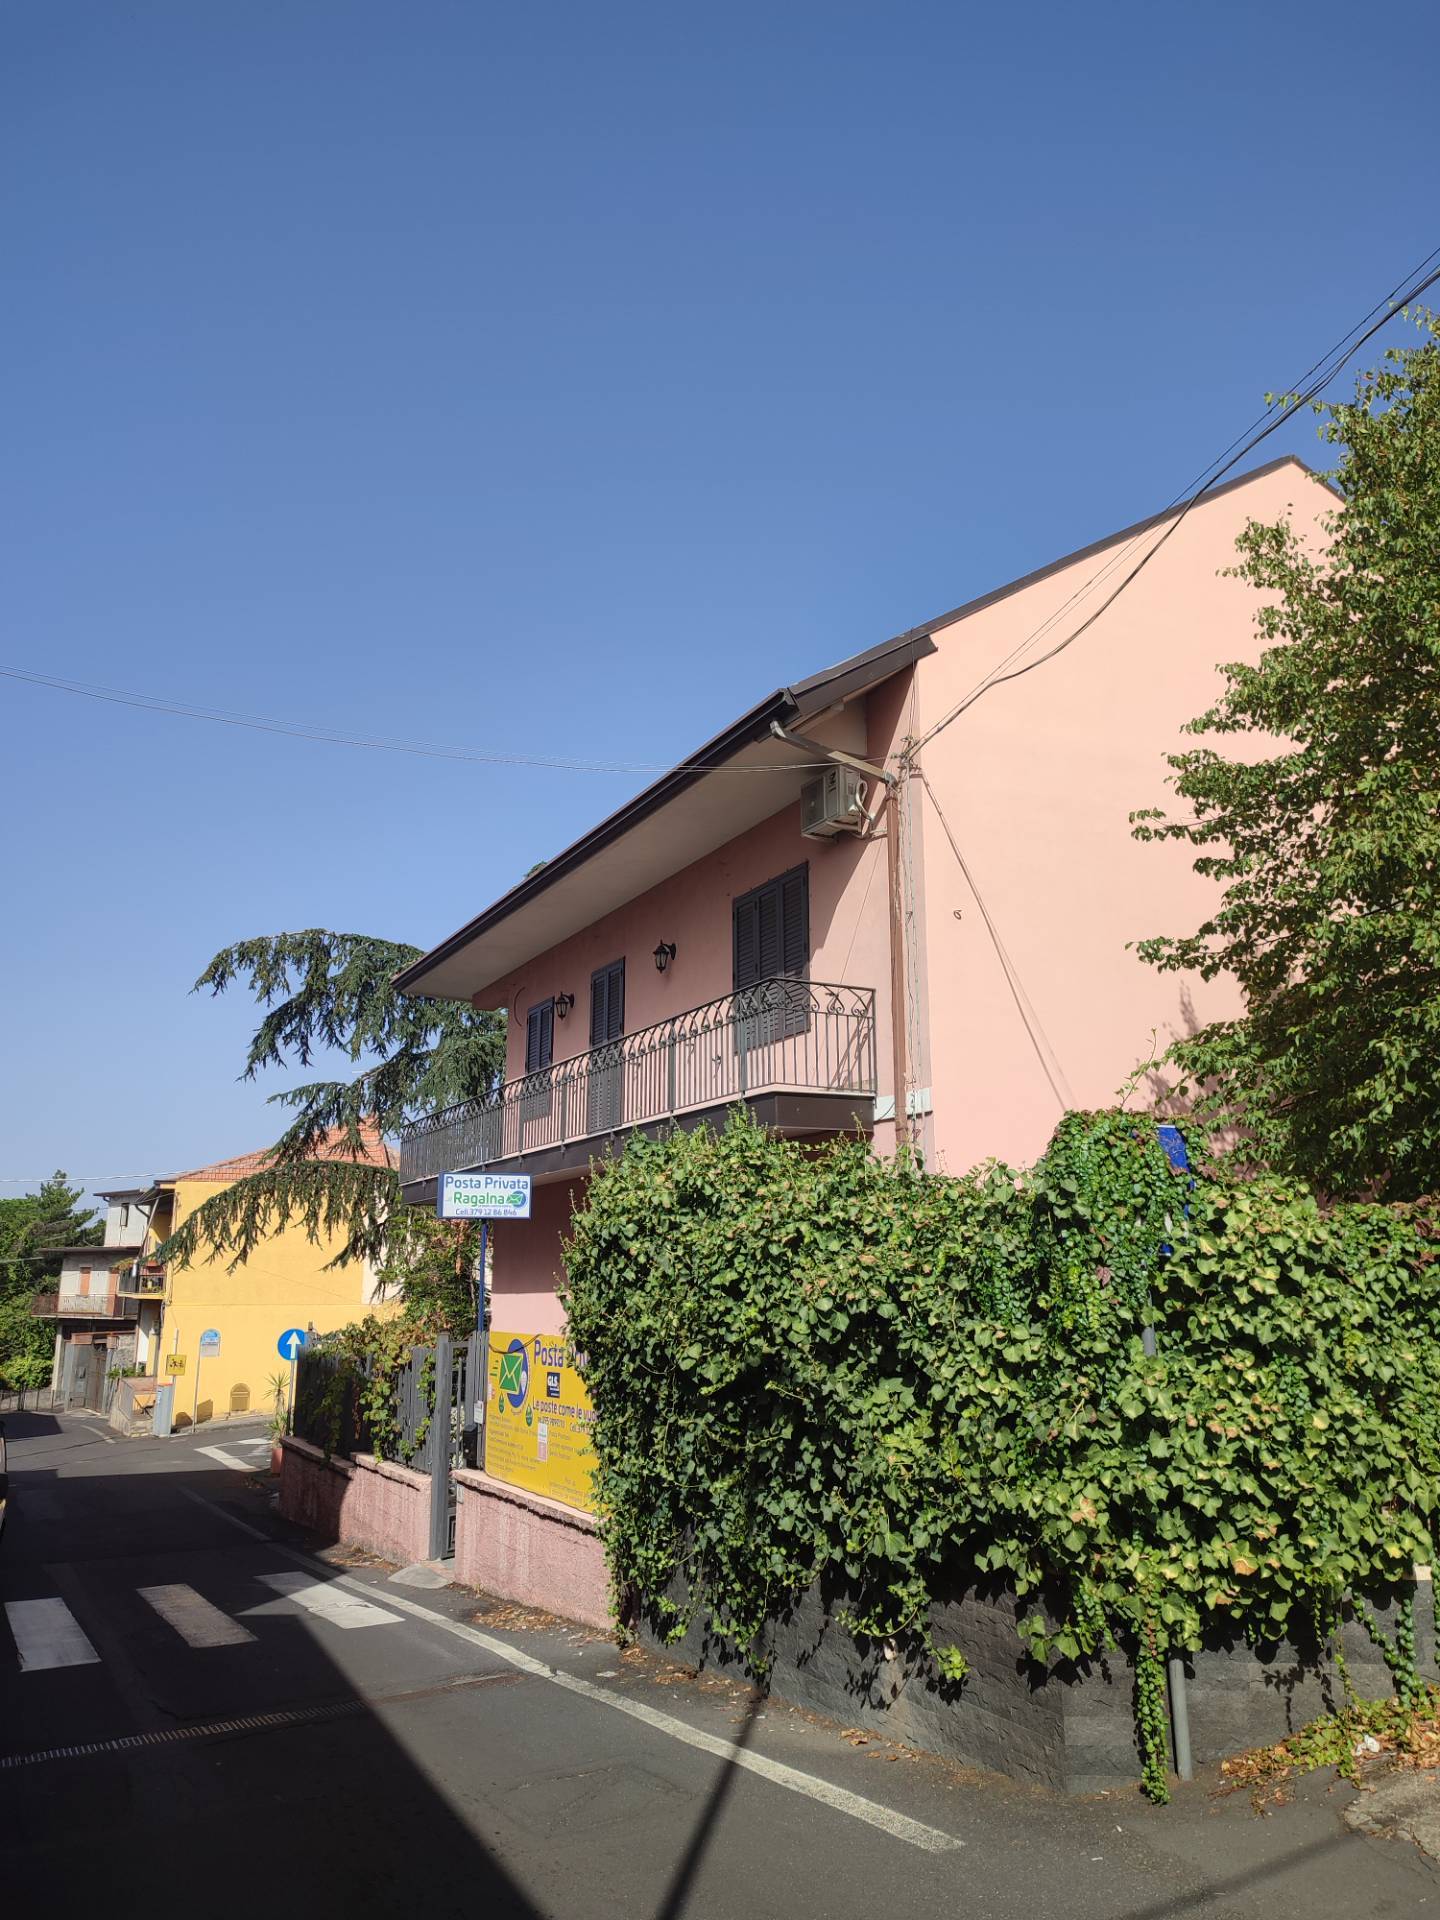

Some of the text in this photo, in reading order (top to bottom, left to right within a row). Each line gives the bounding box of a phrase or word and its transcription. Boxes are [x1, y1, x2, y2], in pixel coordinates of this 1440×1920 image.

[445, 1176, 529, 1190] Posta Privata
[453, 1191, 505, 1207] Ragalna
[534, 1339, 563, 1368] Posta
[547, 1375, 558, 1387] GLS
[533, 1394, 540, 1411] Le
[540, 1399, 558, 1415] poste
[558, 1404, 575, 1419] come
[576, 1402, 583, 1420] le
